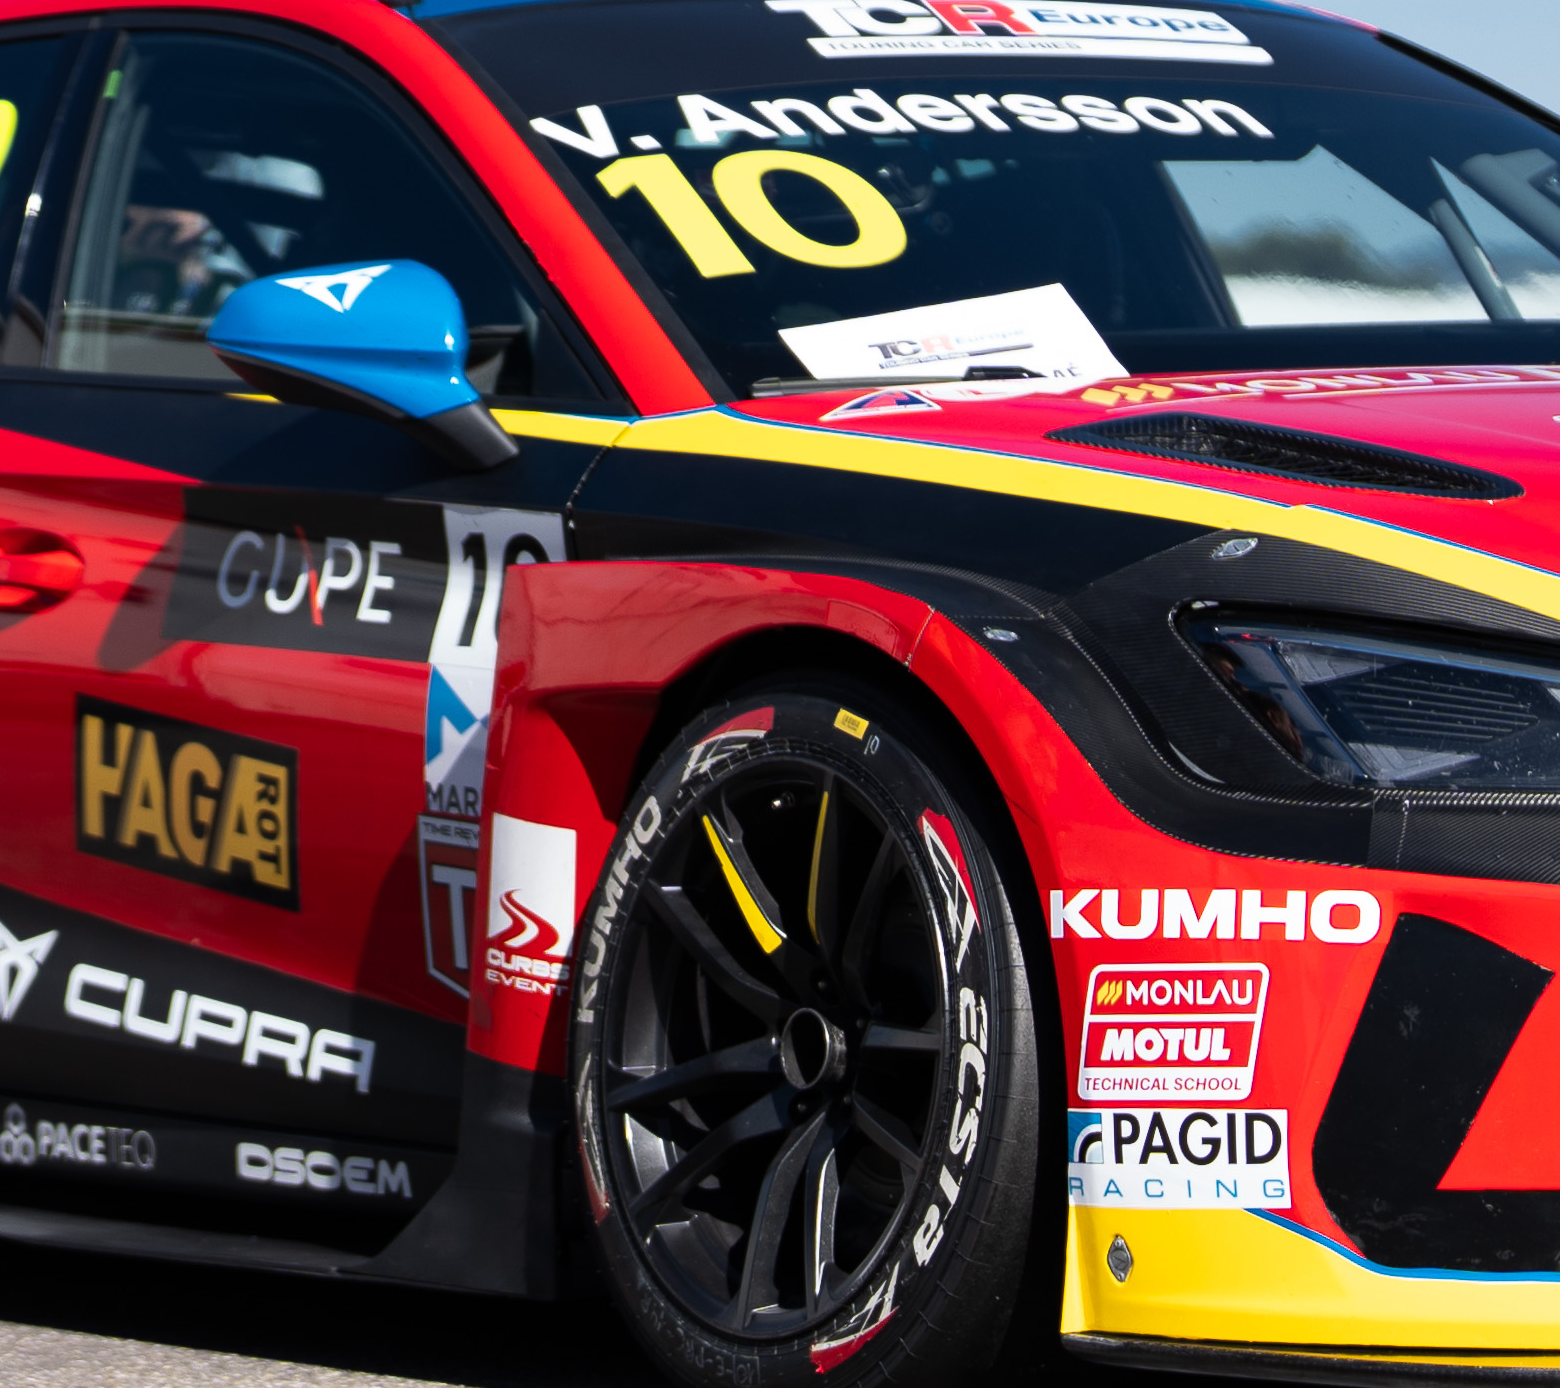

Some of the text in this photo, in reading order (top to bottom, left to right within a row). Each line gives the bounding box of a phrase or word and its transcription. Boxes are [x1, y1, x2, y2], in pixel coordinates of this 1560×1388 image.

[1029, 8, 1229, 34] Europe
[529, 88, 1275, 159] V. Andersson
[595, 149, 907, 280] 10
[82, 713, 291, 890] HAGA
[256, 772, 282, 876] ROT
[576, 793, 663, 1023] KUMHO
[1049, 888, 1381, 944] KUMHO
[486, 947, 570, 981] CURBS
[486, 968, 569, 997] EVENT
[1125, 979, 1254, 1006] MONLAU
[65, 963, 376, 1094] CUPRA
[1100, 1027, 1231, 1062] MOTUL
[1084, 1077, 1242, 1092] TECHNICAL SCHOOL
[1112, 1111, 1282, 1165] PAGID
[236, 1141, 413, 1199] DSOEM
[1069, 1176, 1285, 1199] RACING
